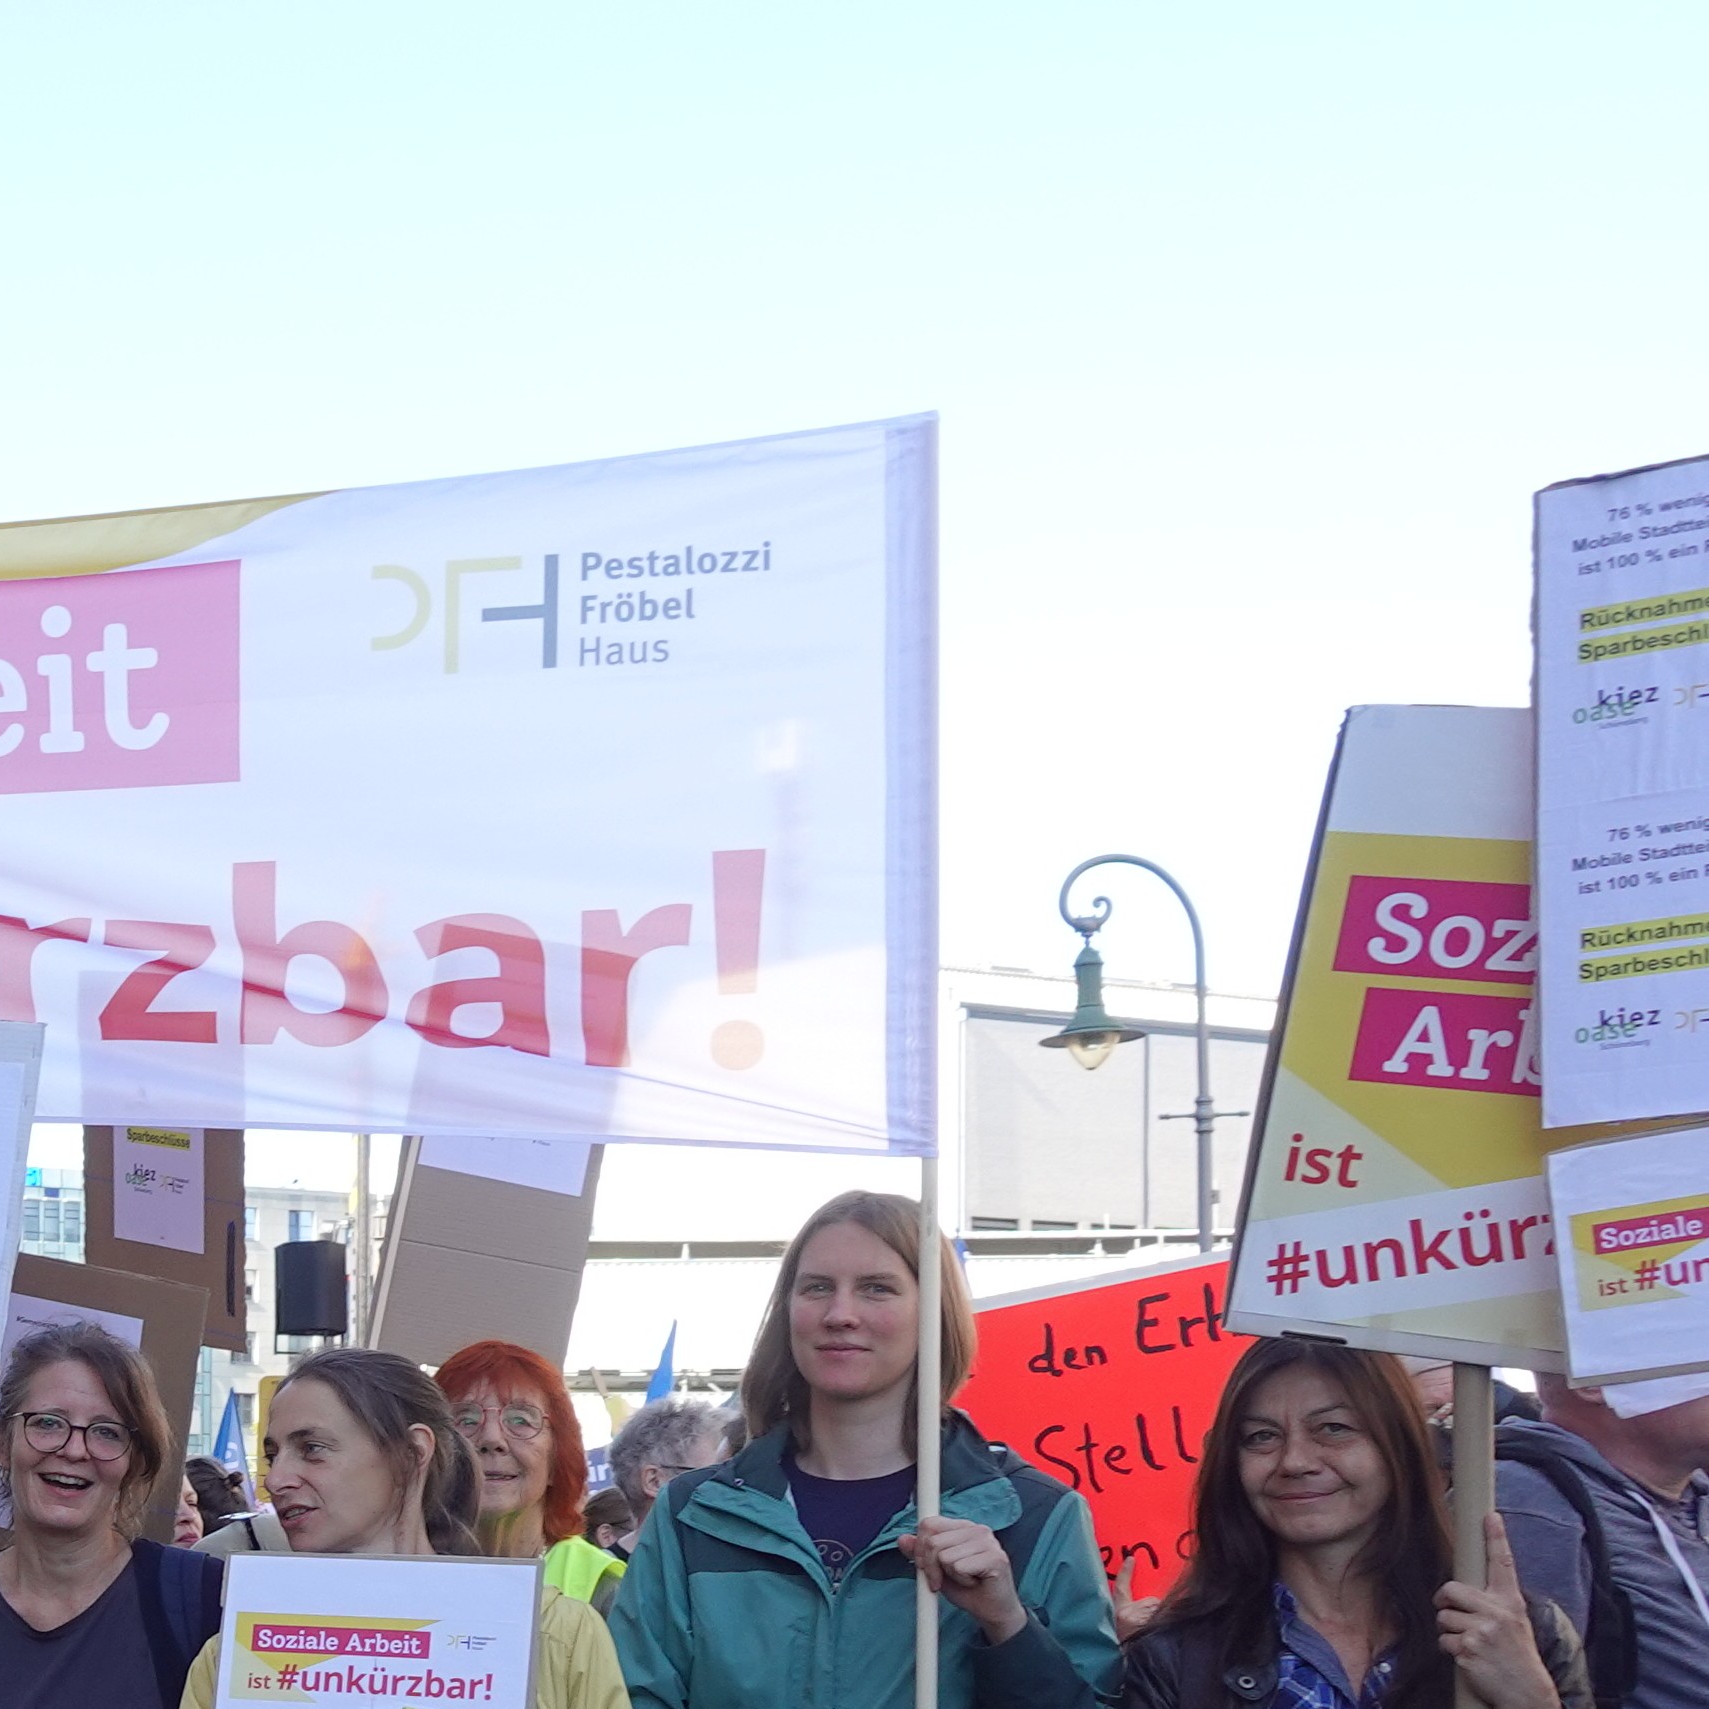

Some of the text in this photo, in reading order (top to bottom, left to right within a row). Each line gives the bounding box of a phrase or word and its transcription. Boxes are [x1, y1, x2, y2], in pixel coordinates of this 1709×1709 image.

[580, 542, 773, 582] Pestalozzi
[580, 590, 696, 625] Fröbel
[580, 634, 671, 667] Haus
[1606, 827, 1629, 841] 76
[1572, 852, 1633, 871] Mobile
[1578, 867, 1698, 894] ist 100 ein
[1578, 950, 1709, 981] Sparbeschl
[1284, 1133, 1363, 1188] ist
[1600, 1216, 1704, 1250] Soziale
[1266, 1210, 1556, 1296] #unkür
[1598, 1278, 1628, 1297] ist
[1028, 1323, 1109, 1377] den
[257, 1628, 422, 1655] Soziale Arbeit
[247, 1664, 493, 1701] ist #unkürzbar!
